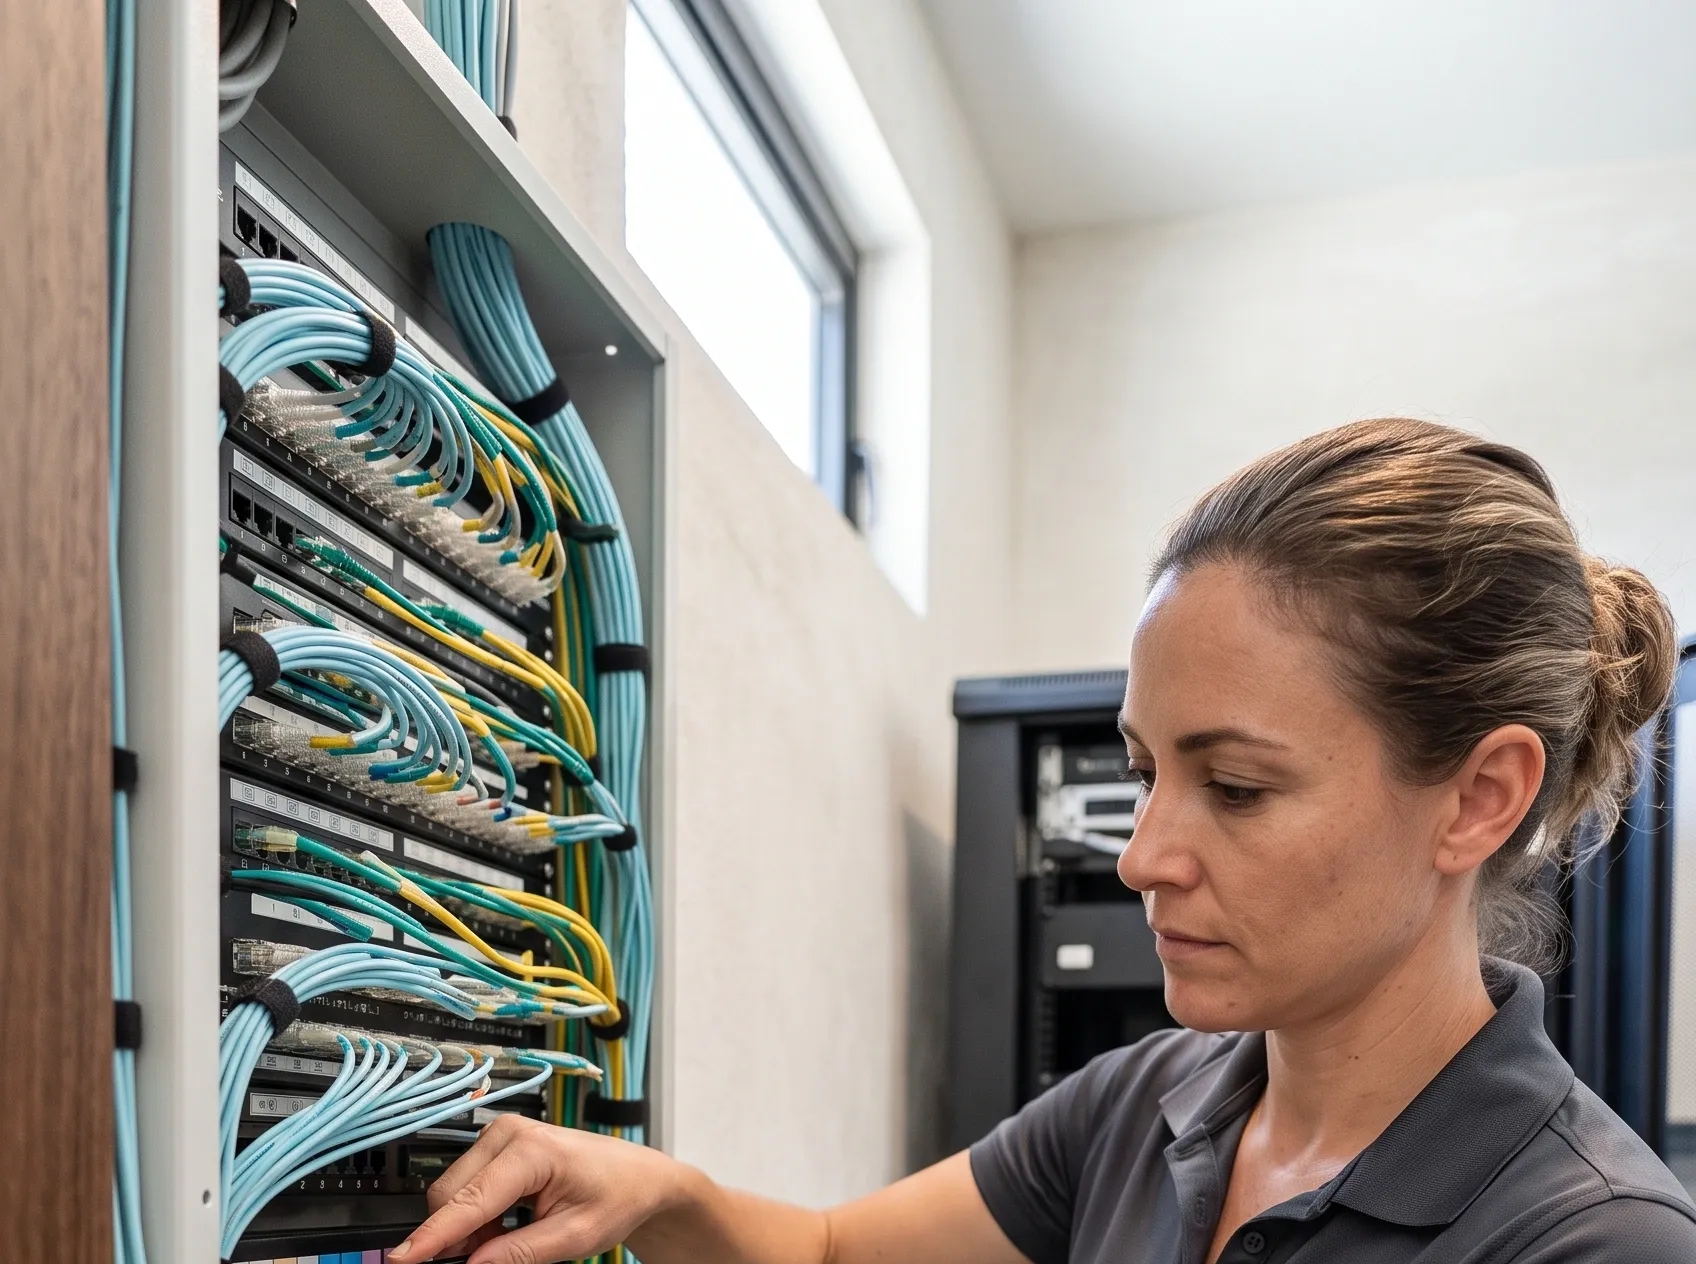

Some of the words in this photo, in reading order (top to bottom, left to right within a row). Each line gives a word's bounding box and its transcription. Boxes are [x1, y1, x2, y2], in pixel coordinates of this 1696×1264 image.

[300, 1180, 305, 1190] 2
[320, 1180, 325, 1189] 3
[338, 1180, 343, 1189] 4
[356, 1180, 361, 1189] 5
